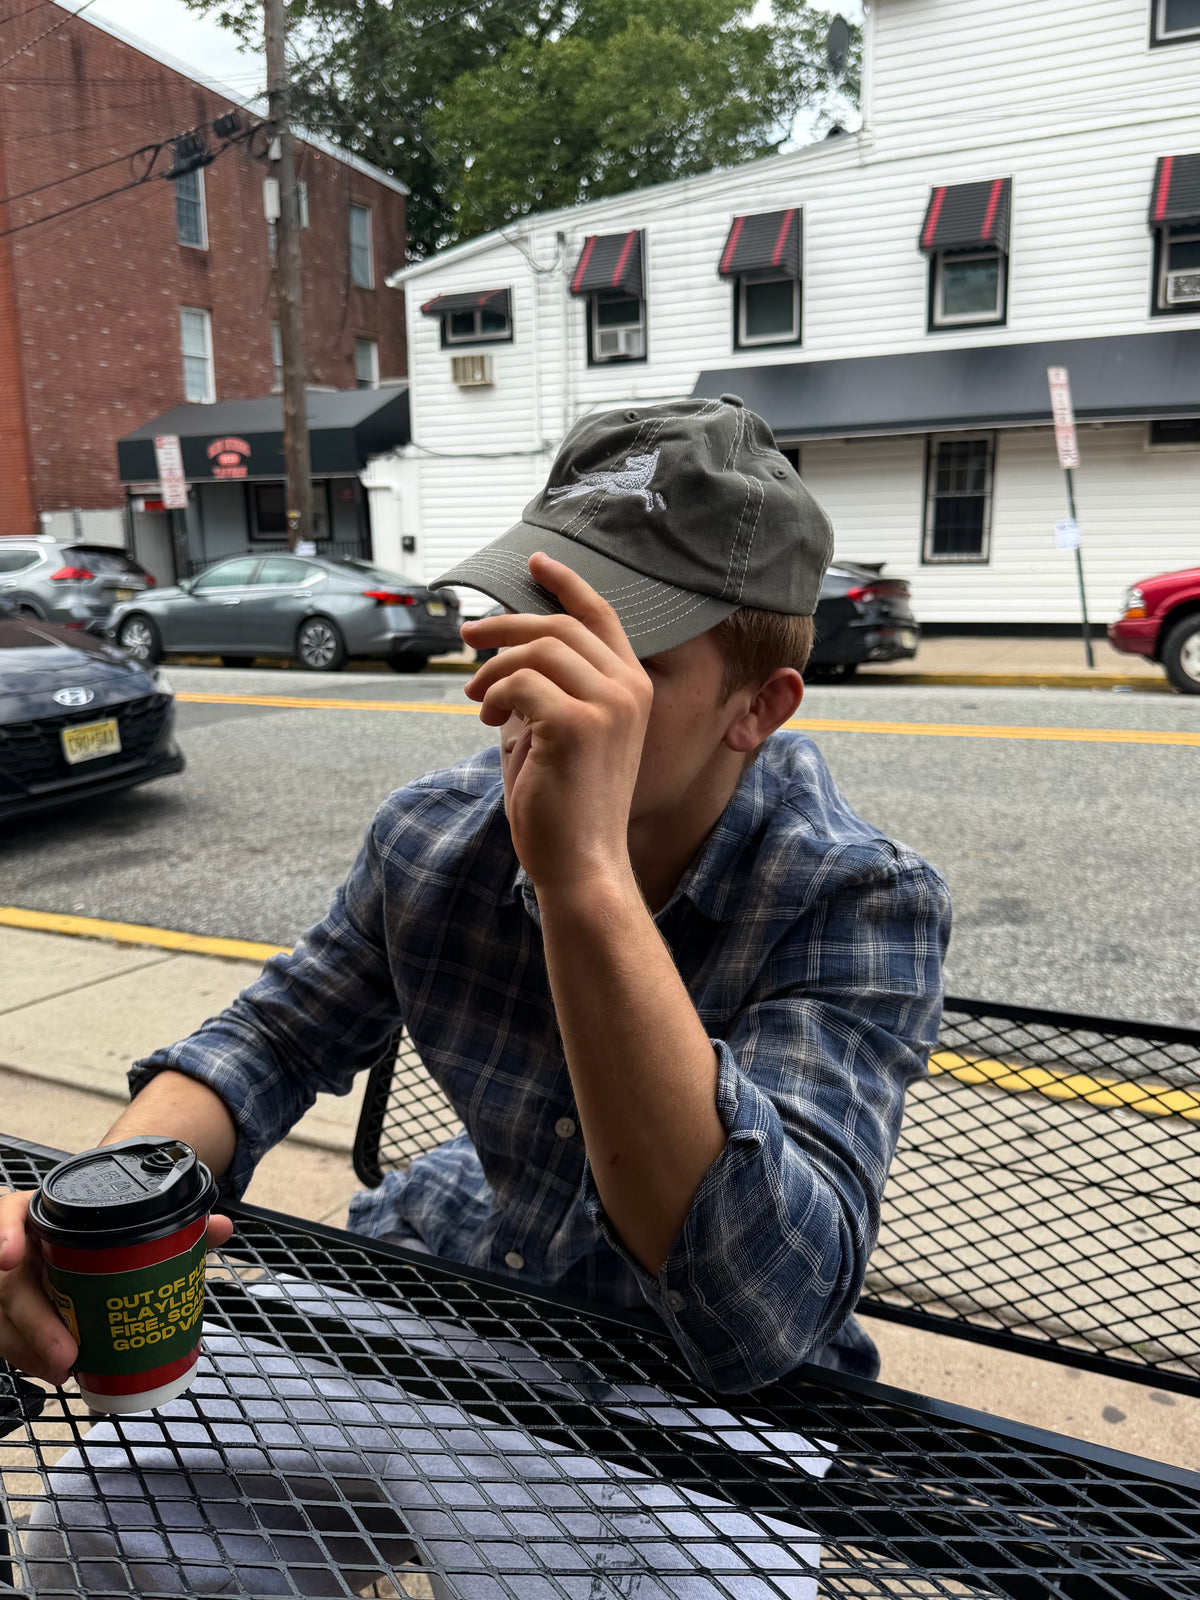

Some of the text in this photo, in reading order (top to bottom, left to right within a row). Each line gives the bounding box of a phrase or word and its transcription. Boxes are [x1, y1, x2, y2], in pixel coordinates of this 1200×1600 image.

[106, 1290, 155, 1311] OUT
[157, 1277, 186, 1299] OF
[110, 1317, 165, 1338] FIRE.
[112, 1325, 176, 1351] GOOD
